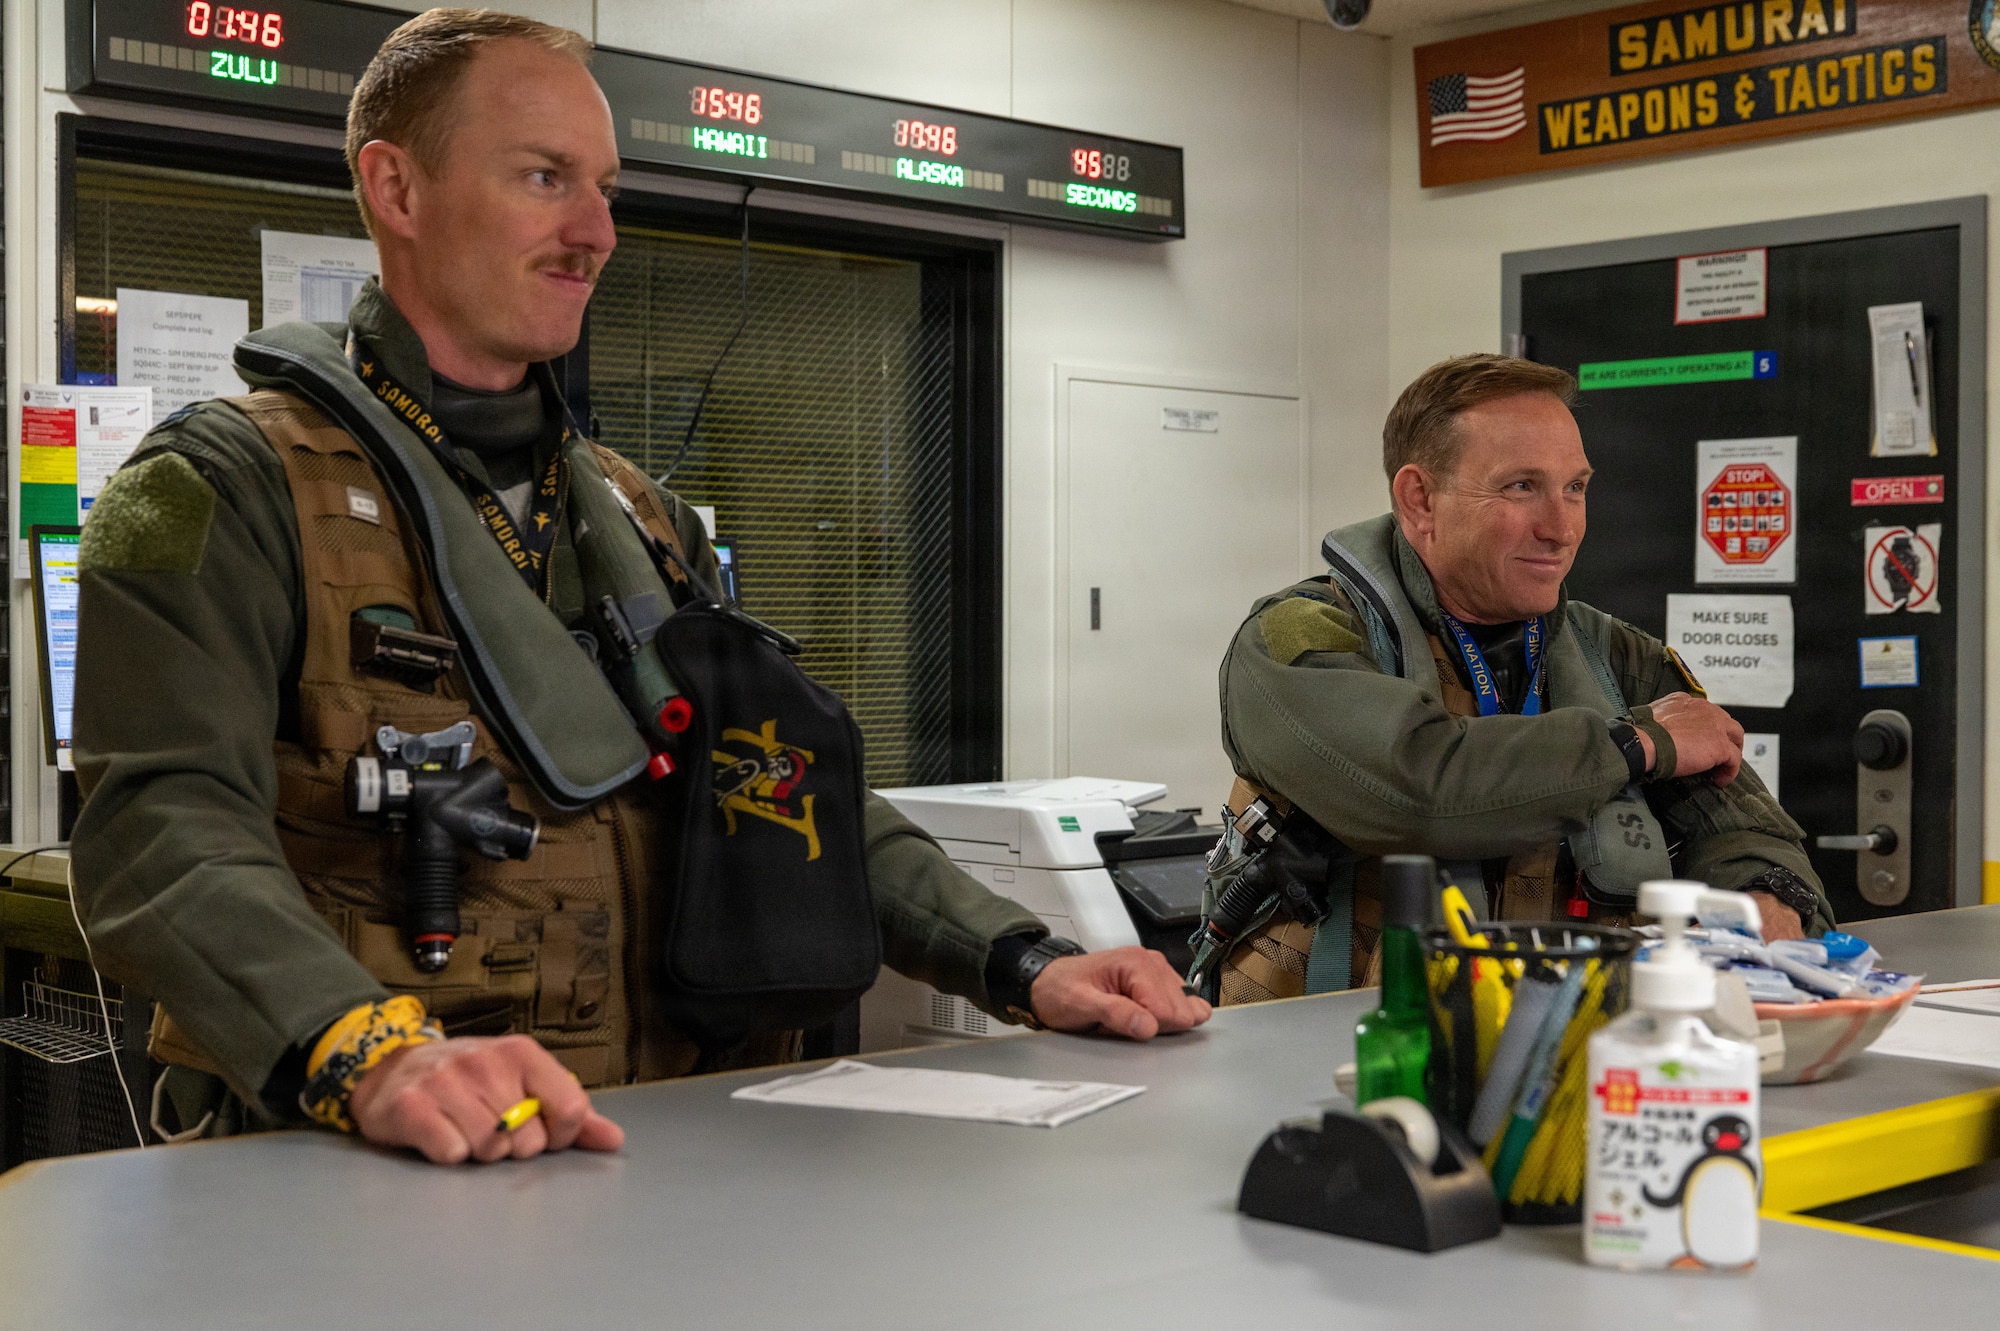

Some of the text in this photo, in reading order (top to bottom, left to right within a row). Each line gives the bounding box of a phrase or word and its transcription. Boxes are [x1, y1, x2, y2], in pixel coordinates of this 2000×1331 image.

[1617, 0, 1847, 71] SAMURAI
[210, 51, 277, 84] ZULU
[1543, 80, 1719, 149] WEAPONS
[1767, 44, 1936, 115] TACTICS
[692, 126, 768, 159] HAWAII
[896, 158, 965, 188] ALASKA
[1065, 183, 1137, 213] SECONDS
[152, 322, 187, 334] Complete
[208, 352, 229, 361] PROC
[187, 376, 202, 384] APP
[1583, 370, 1596, 381] WE
[1599, 369, 1617, 380] ARE
[1619, 365, 1674, 379] CURRENTLY
[1676, 361, 1733, 375] OPERATING
[1759, 358, 1771, 374] 5
[202, 389, 216, 398] APP
[376, 380, 445, 444] SAMURAI
[1725, 469, 1766, 484] STOP!
[1865, 481, 1914, 501] OPEN
[476, 493, 530, 570] SAMURAI
[1693, 611, 1769, 625] MAKE SURE
[1682, 632, 1779, 647] DOOR CLOSES
[1463, 643, 1492, 696] NATION
[1698, 654, 1761, 669] -SHAGGY
[1600, 1120, 1696, 1146] アルコール
[1600, 1145, 1663, 1169] ジェル
